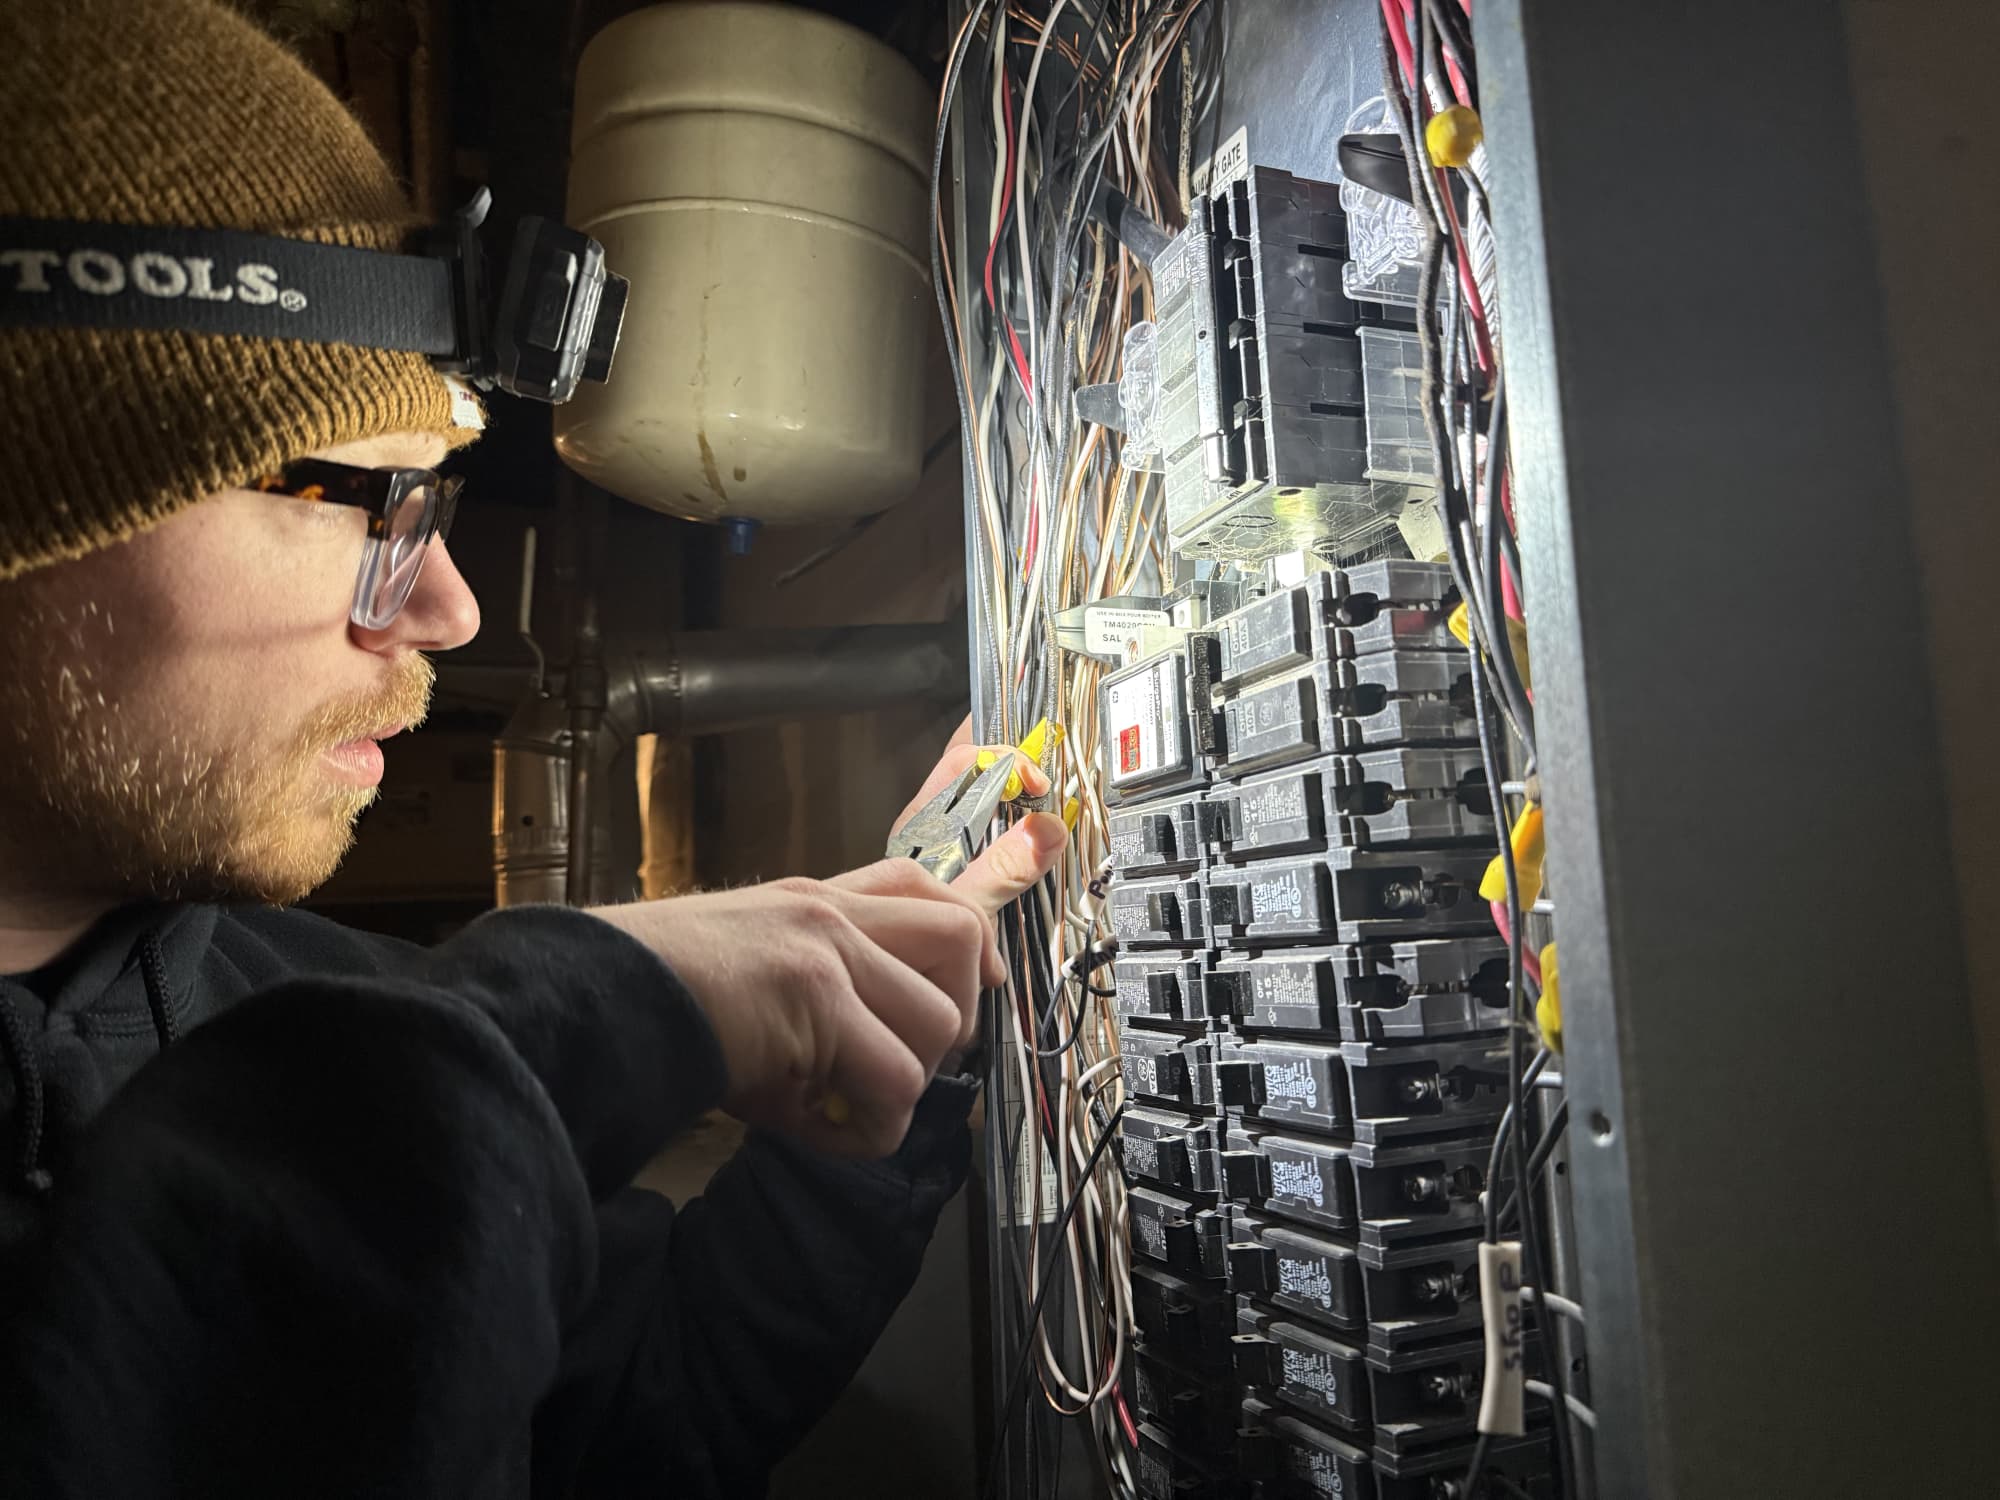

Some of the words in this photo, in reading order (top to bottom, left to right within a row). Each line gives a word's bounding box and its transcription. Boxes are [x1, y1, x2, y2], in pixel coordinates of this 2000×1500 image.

[1221, 141, 1241, 174] GATE
[1256, 979, 1264, 999] OFF
[1264, 977, 1272, 1000] 15
[1148, 1063, 1156, 1091] 20A
[1188, 1067, 1196, 1086] ON
[1188, 1155, 1197, 1175] ON
